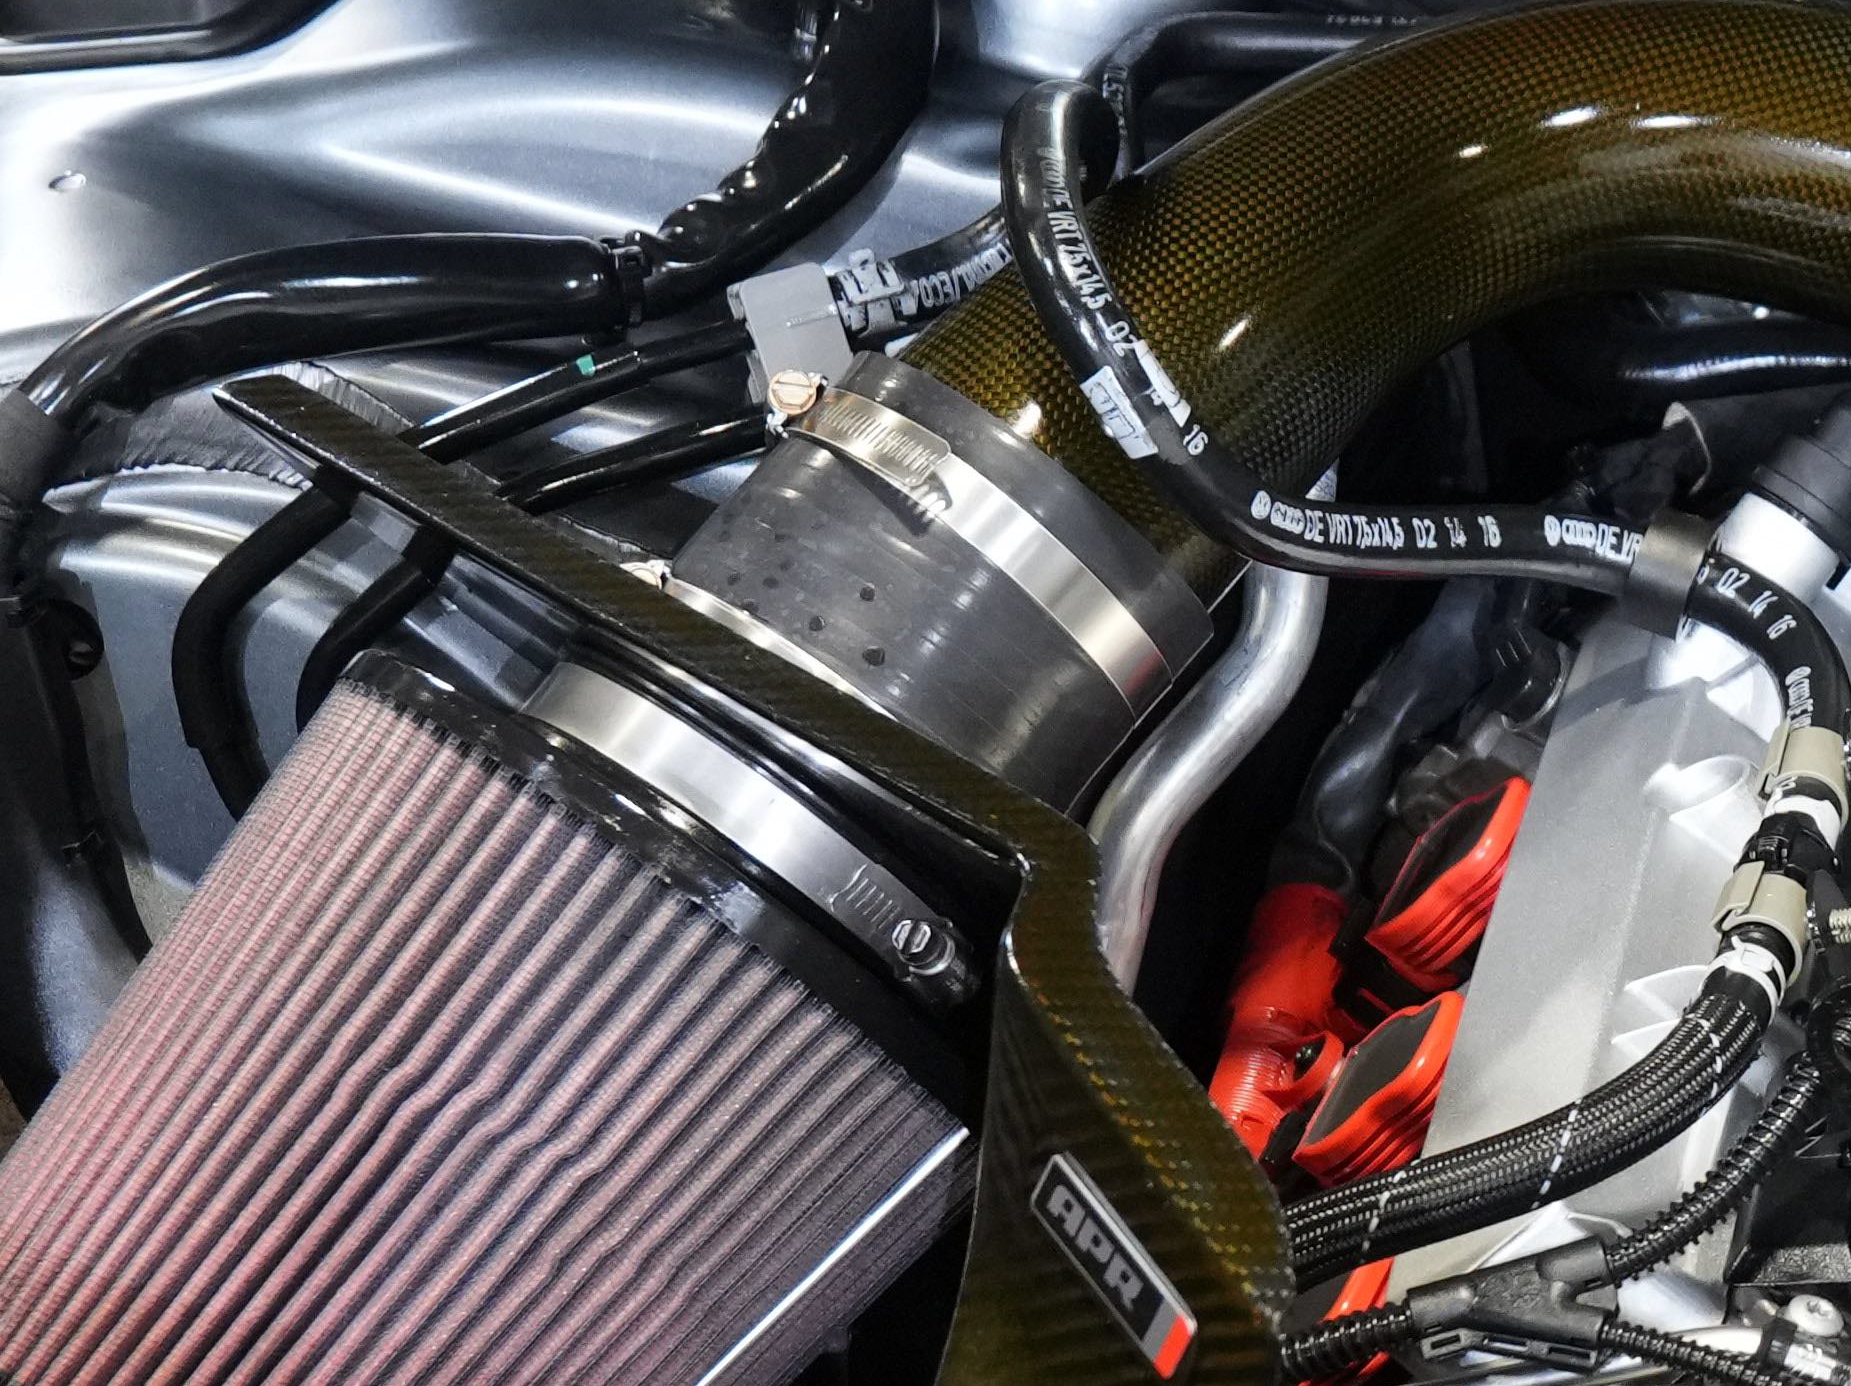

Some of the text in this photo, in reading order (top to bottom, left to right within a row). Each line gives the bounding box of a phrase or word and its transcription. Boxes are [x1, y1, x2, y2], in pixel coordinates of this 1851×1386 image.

[1048, 212, 1083, 243] VRT
[1105, 319, 1138, 357] 02
[1182, 424, 1209, 456] 16
[1303, 509, 1325, 544] DE
[1411, 517, 1438, 549] 02
[1477, 515, 1503, 548] 16
[1621, 528, 1645, 564] VR
[1715, 567, 1751, 599] 02
[1747, 589, 1778, 620] 14
[1766, 613, 1798, 641] 16
[1046, 1184, 1145, 1313] APR
